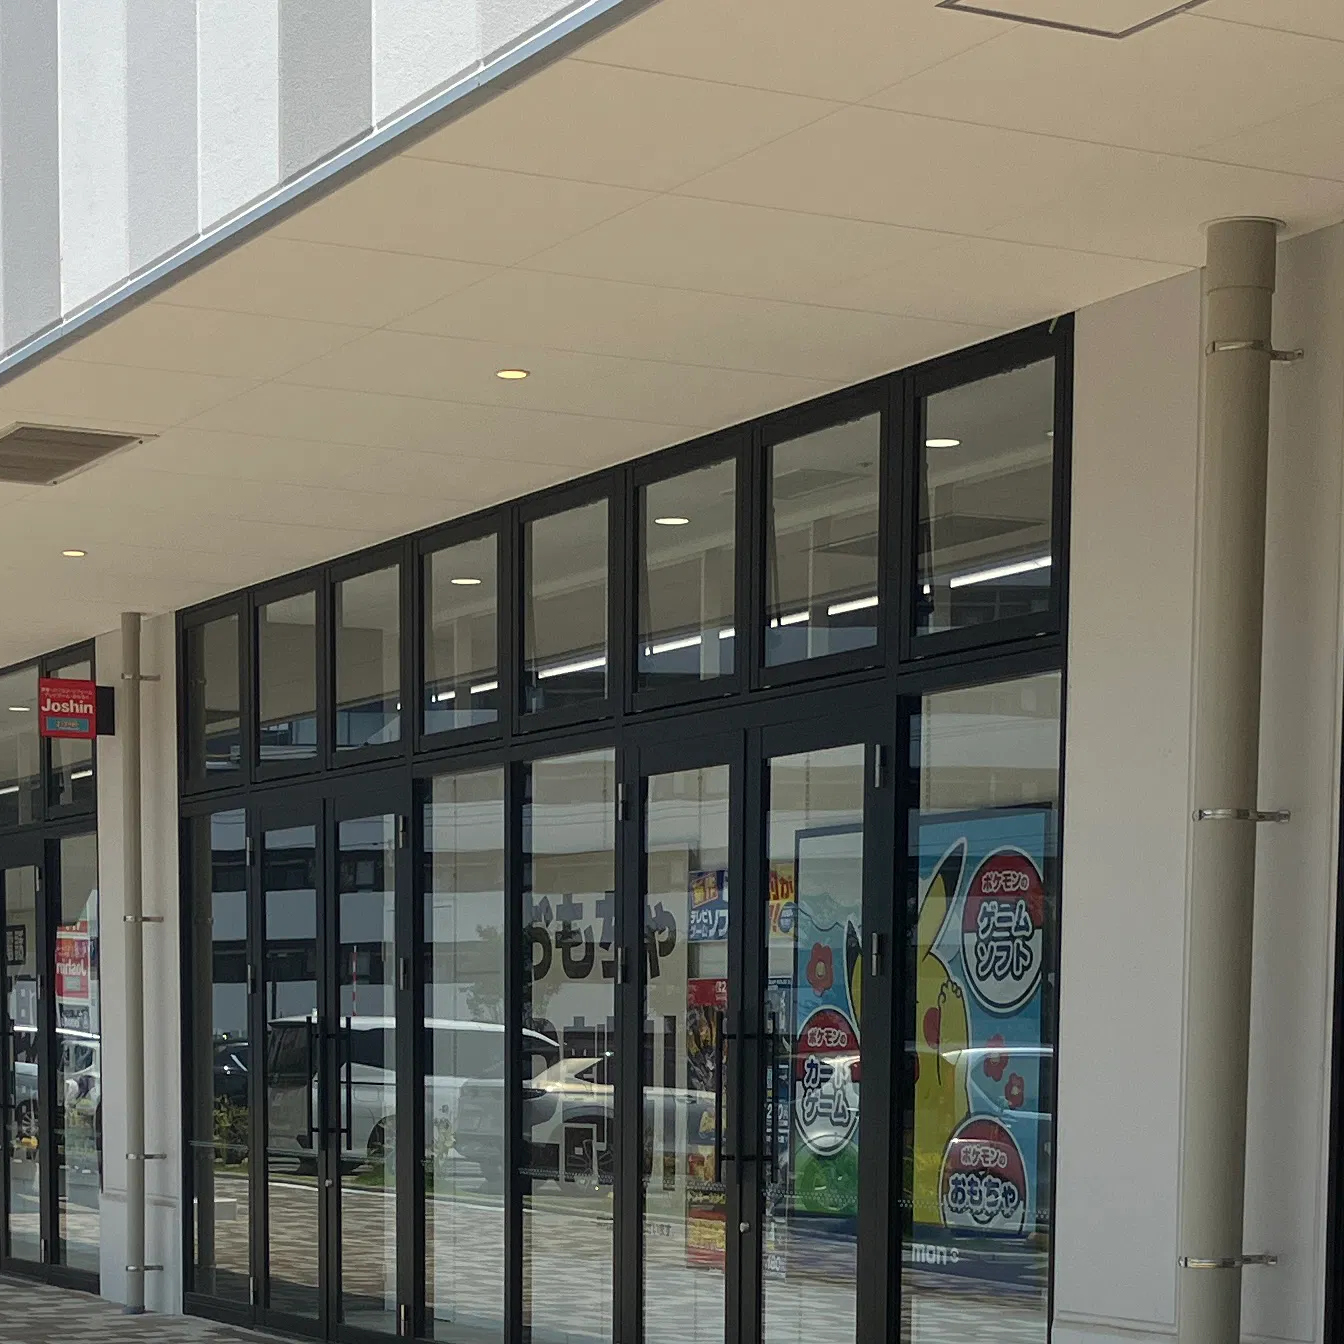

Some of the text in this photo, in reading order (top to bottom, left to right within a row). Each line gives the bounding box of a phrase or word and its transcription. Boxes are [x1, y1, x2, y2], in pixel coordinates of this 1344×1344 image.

[41, 698, 94, 714] Joshin
[981, 870, 1030, 893] ポケモンの
[977, 899, 1033, 940] ゲーム
[976, 938, 1033, 979] ソフト
[807, 1026, 848, 1047] ポケモンの
[960, 1144, 1008, 1168] ポケモンの
[948, 1172, 1019, 1213] おもちゃ
